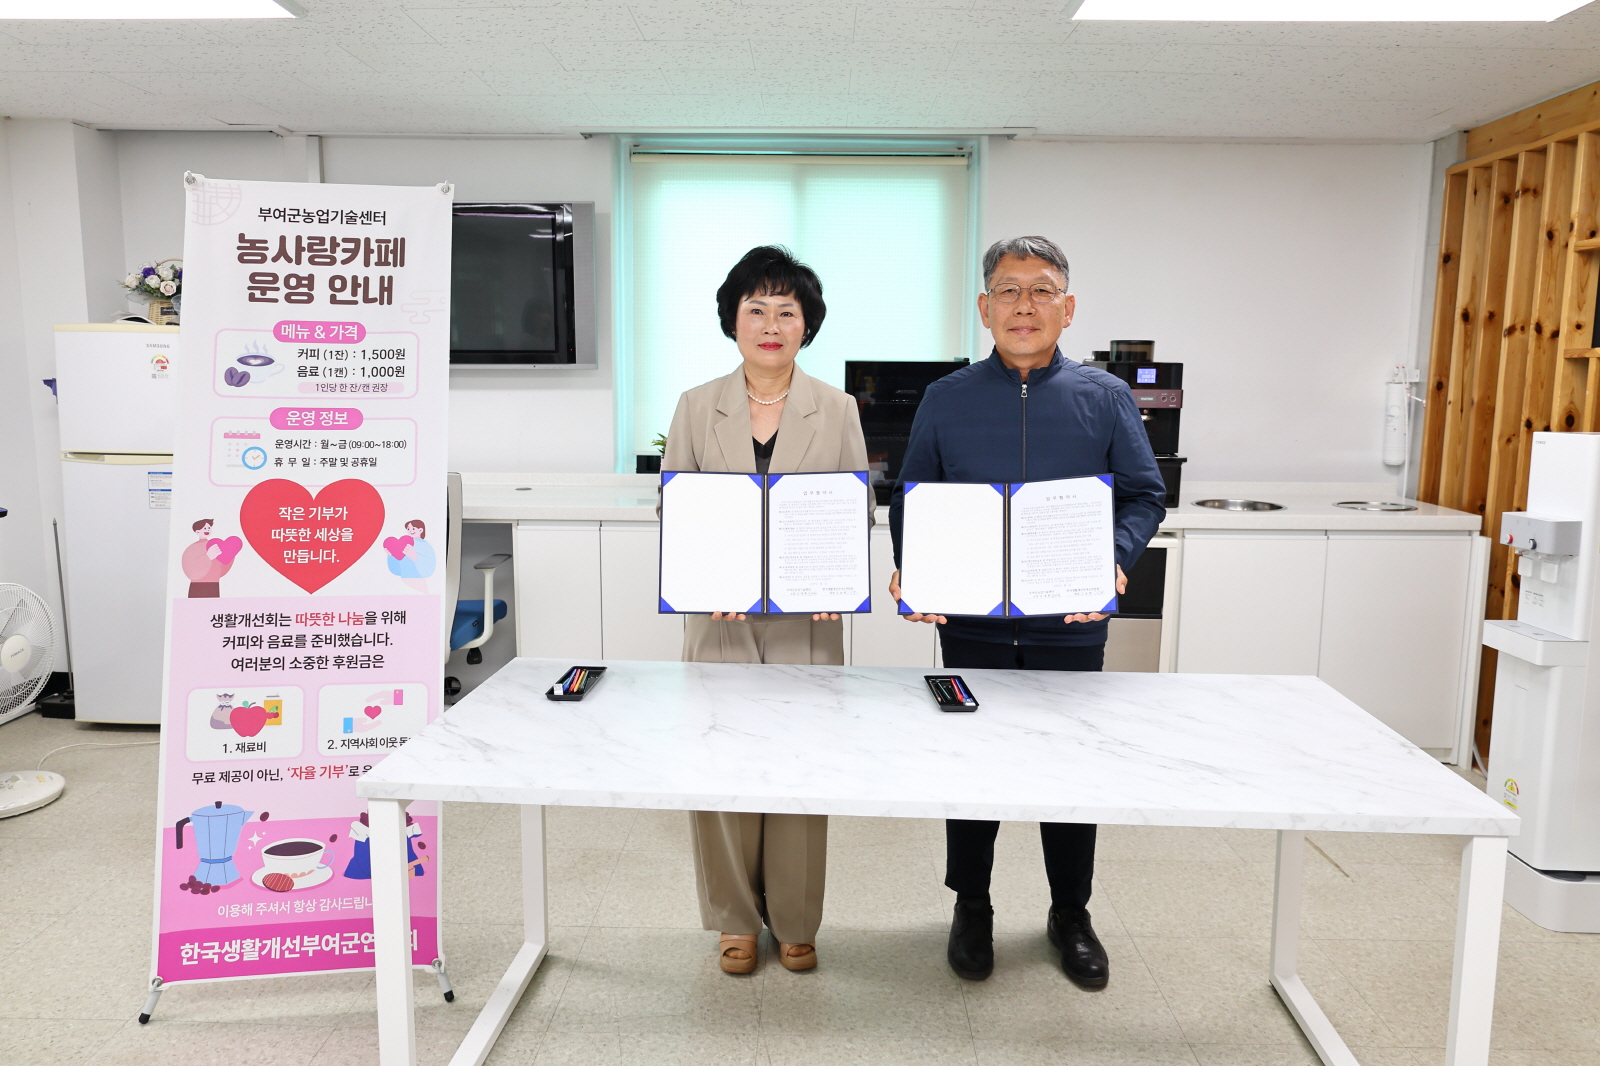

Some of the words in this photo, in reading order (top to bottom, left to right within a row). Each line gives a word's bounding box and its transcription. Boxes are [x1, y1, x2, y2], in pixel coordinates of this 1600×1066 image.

[257, 208, 386, 225] 부여군농업기술센터
[236, 233, 406, 267] 농사랑카페
[246, 272, 315, 304] 운영
[328, 275, 394, 305] 안내
[280, 324, 311, 339] 메뉴
[313, 325, 326, 338] &
[329, 325, 358, 340] 가격
[297, 348, 320, 360] 커피
[323, 350, 349, 361] (1잔)
[361, 349, 406, 360] 1,500원
[296, 366, 320, 377] 음료
[322, 367, 348, 378] (1캔)
[360, 366, 405, 378] 1,000원
[315, 383, 338, 392] 1인당
[338, 383, 348, 392] 한
[349, 384, 370, 392] 잔/캔
[371, 383, 389, 392] 권장
[285, 411, 316, 426] 운영
[319, 411, 349, 426] 정보
[274, 439, 312, 449] 운영시간
[319, 458, 338, 467] 주말
[339, 458, 349, 467] 및
[350, 457, 377, 467] 공휴일
[278, 507, 306, 520] 작은
[308, 507, 349, 520] 기부가
[271, 528, 312, 542] 따뜻한
[313, 528, 354, 541] 세상을
[283, 549, 340, 563] 만듭니다.
[210, 613, 293, 628] 생활개선회는
[295, 612, 336, 627] 따뜻한
[338, 611, 378, 625] 나눔을
[380, 611, 407, 624] 위해
[222, 635, 265, 649] 커피와
[266, 635, 308, 649] 음료를
[310, 632, 393, 648] 준비했습니다.
[230, 656, 285, 672] 여러분의
[288, 656, 330, 670] 소중한
[332, 655, 385, 669] 후원금은
[222, 744, 233, 753] 1.
[235, 742, 267, 753] 재료비
[327, 740, 338, 749] 2.
[340, 738, 378, 749] 지역사회
[379, 736, 398, 749] 이웃
[191, 772, 216, 785] 무료
[218, 770, 254, 783] 제공이
[256, 769, 284, 781] 아닌,
[217, 903, 253, 918] 이용해
[255, 901, 291, 915] 주셔서
[293, 899, 318, 913] 항상
[319, 896, 373, 912] 감사드립
[180, 929, 418, 965] 한국생활개선부여군연
